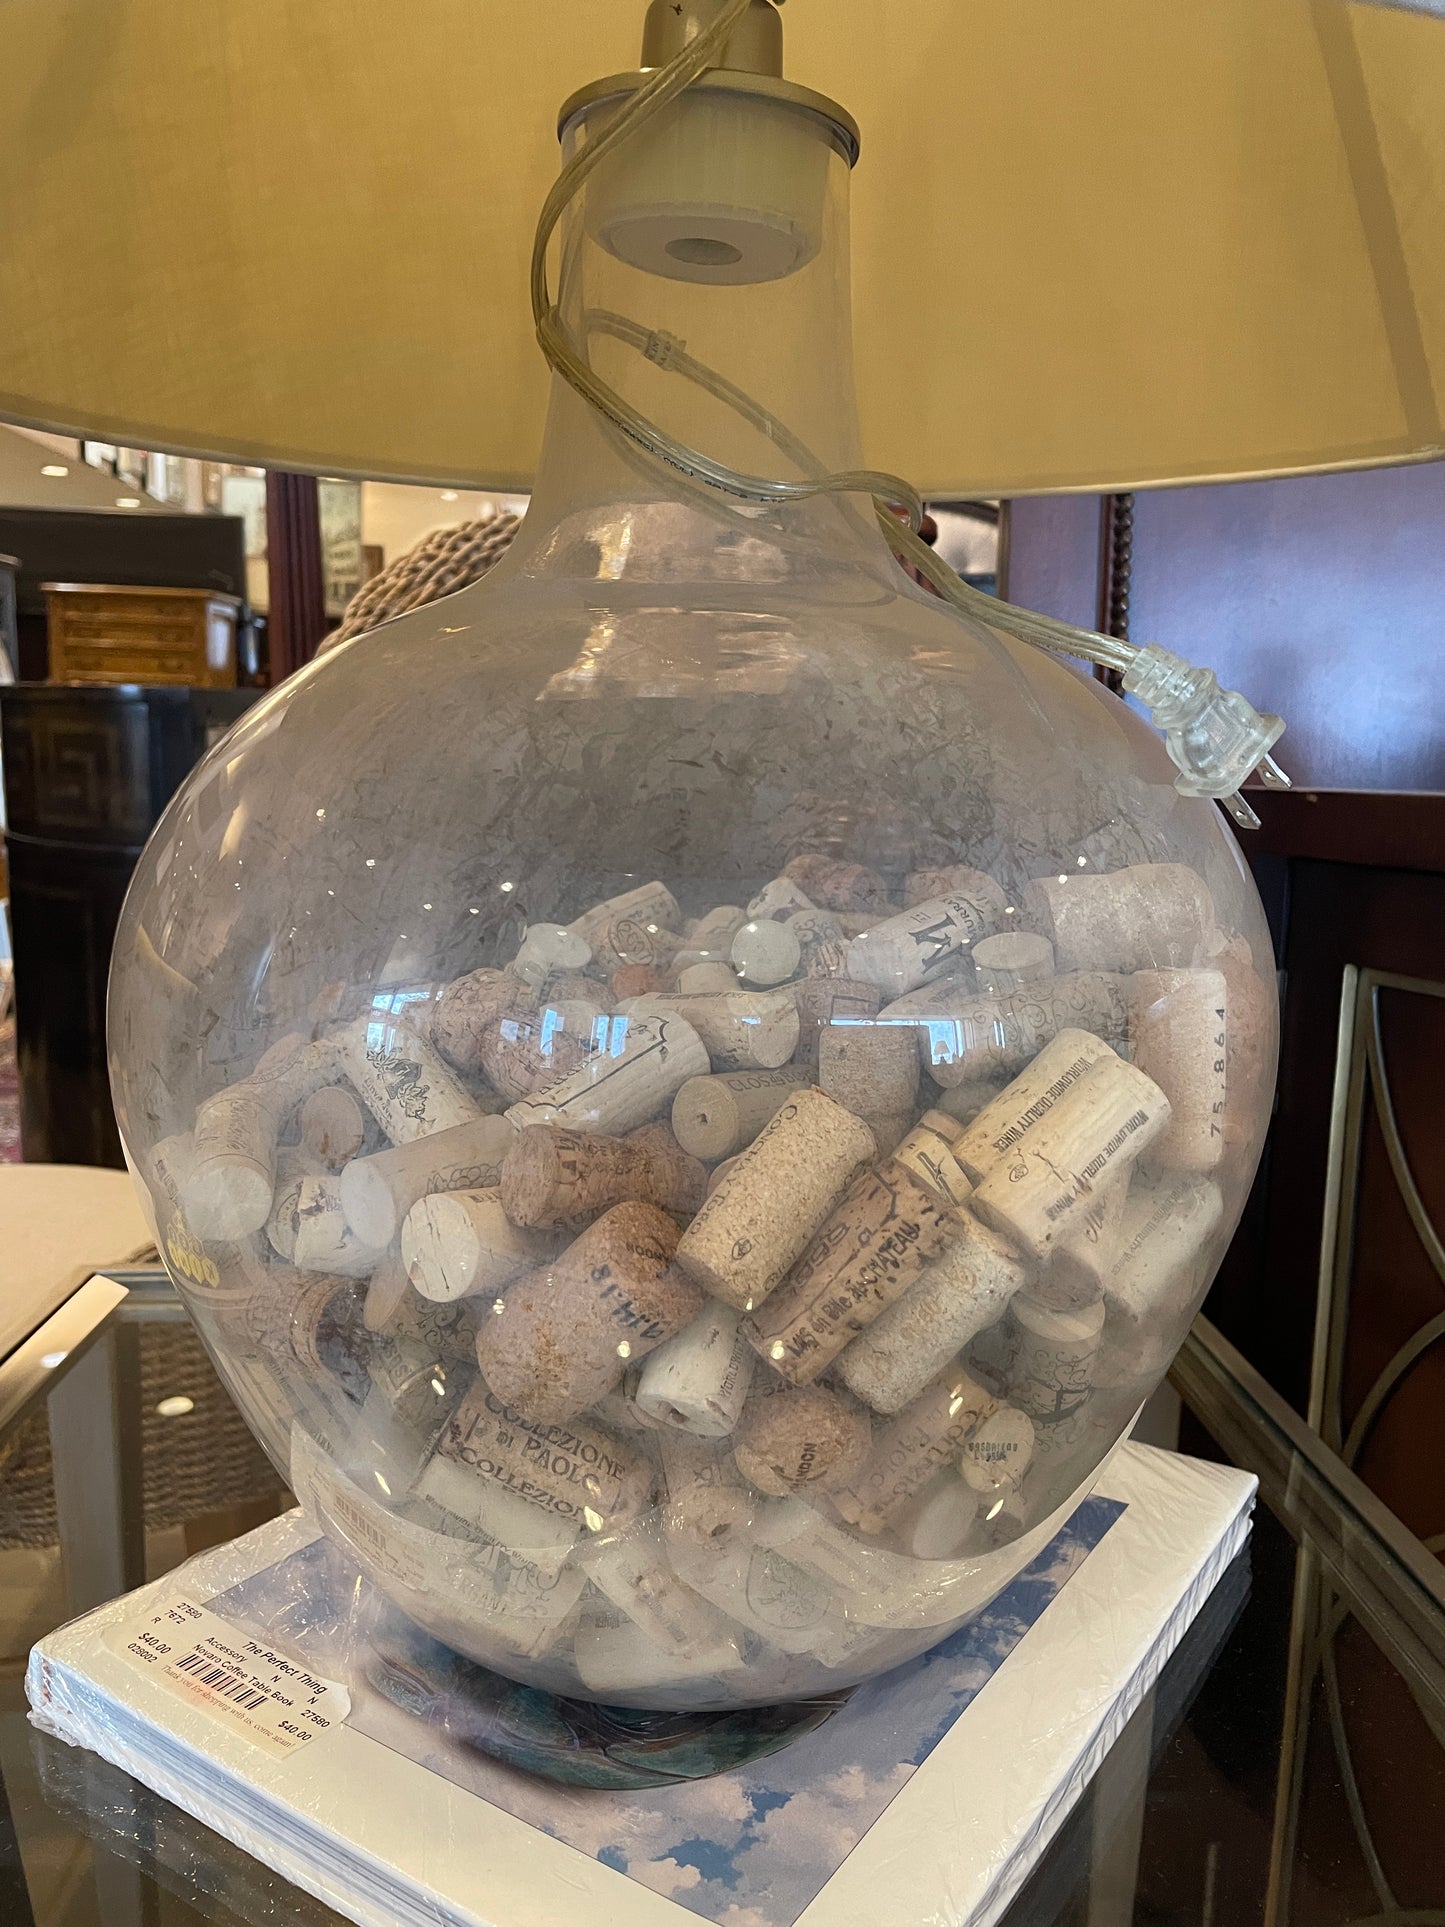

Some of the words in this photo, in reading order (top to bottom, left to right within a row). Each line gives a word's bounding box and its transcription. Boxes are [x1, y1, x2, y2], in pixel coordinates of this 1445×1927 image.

[727, 1074, 771, 1092] CLOS
[1046, 1057, 1093, 1103] WORLDWIDE
[1019, 1095, 1055, 1132] QUALITY
[1104, 1109, 1150, 1158] WORLDWIDE
[733, 1104, 798, 1175] CONCHA
[992, 1126, 1023, 1153] WINES
[689, 1190, 730, 1236] TORO
[523, 1438, 602, 1491] PAOLO
[151, 1616, 162, 1624] R
[177, 1603, 203, 1619] 27580
[138, 1632, 172, 1655] $40.00
[193, 1644, 222, 1664] Novaro
[221, 1661, 248, 1680] Coffee
[248, 1676, 272, 1694] Table
[271, 1691, 295, 1707] Book
[205, 1637, 248, 1663] Accessory
[270, 1675, 282, 1683] N
[307, 1696, 319, 1705] N
[242, 1641, 263, 1655] The
[260, 1652, 300, 1676] Perfect
[297, 1673, 329, 1695] Thing
[278, 1720, 313, 1741] $40.00
[300, 1709, 331, 1728] 27580
